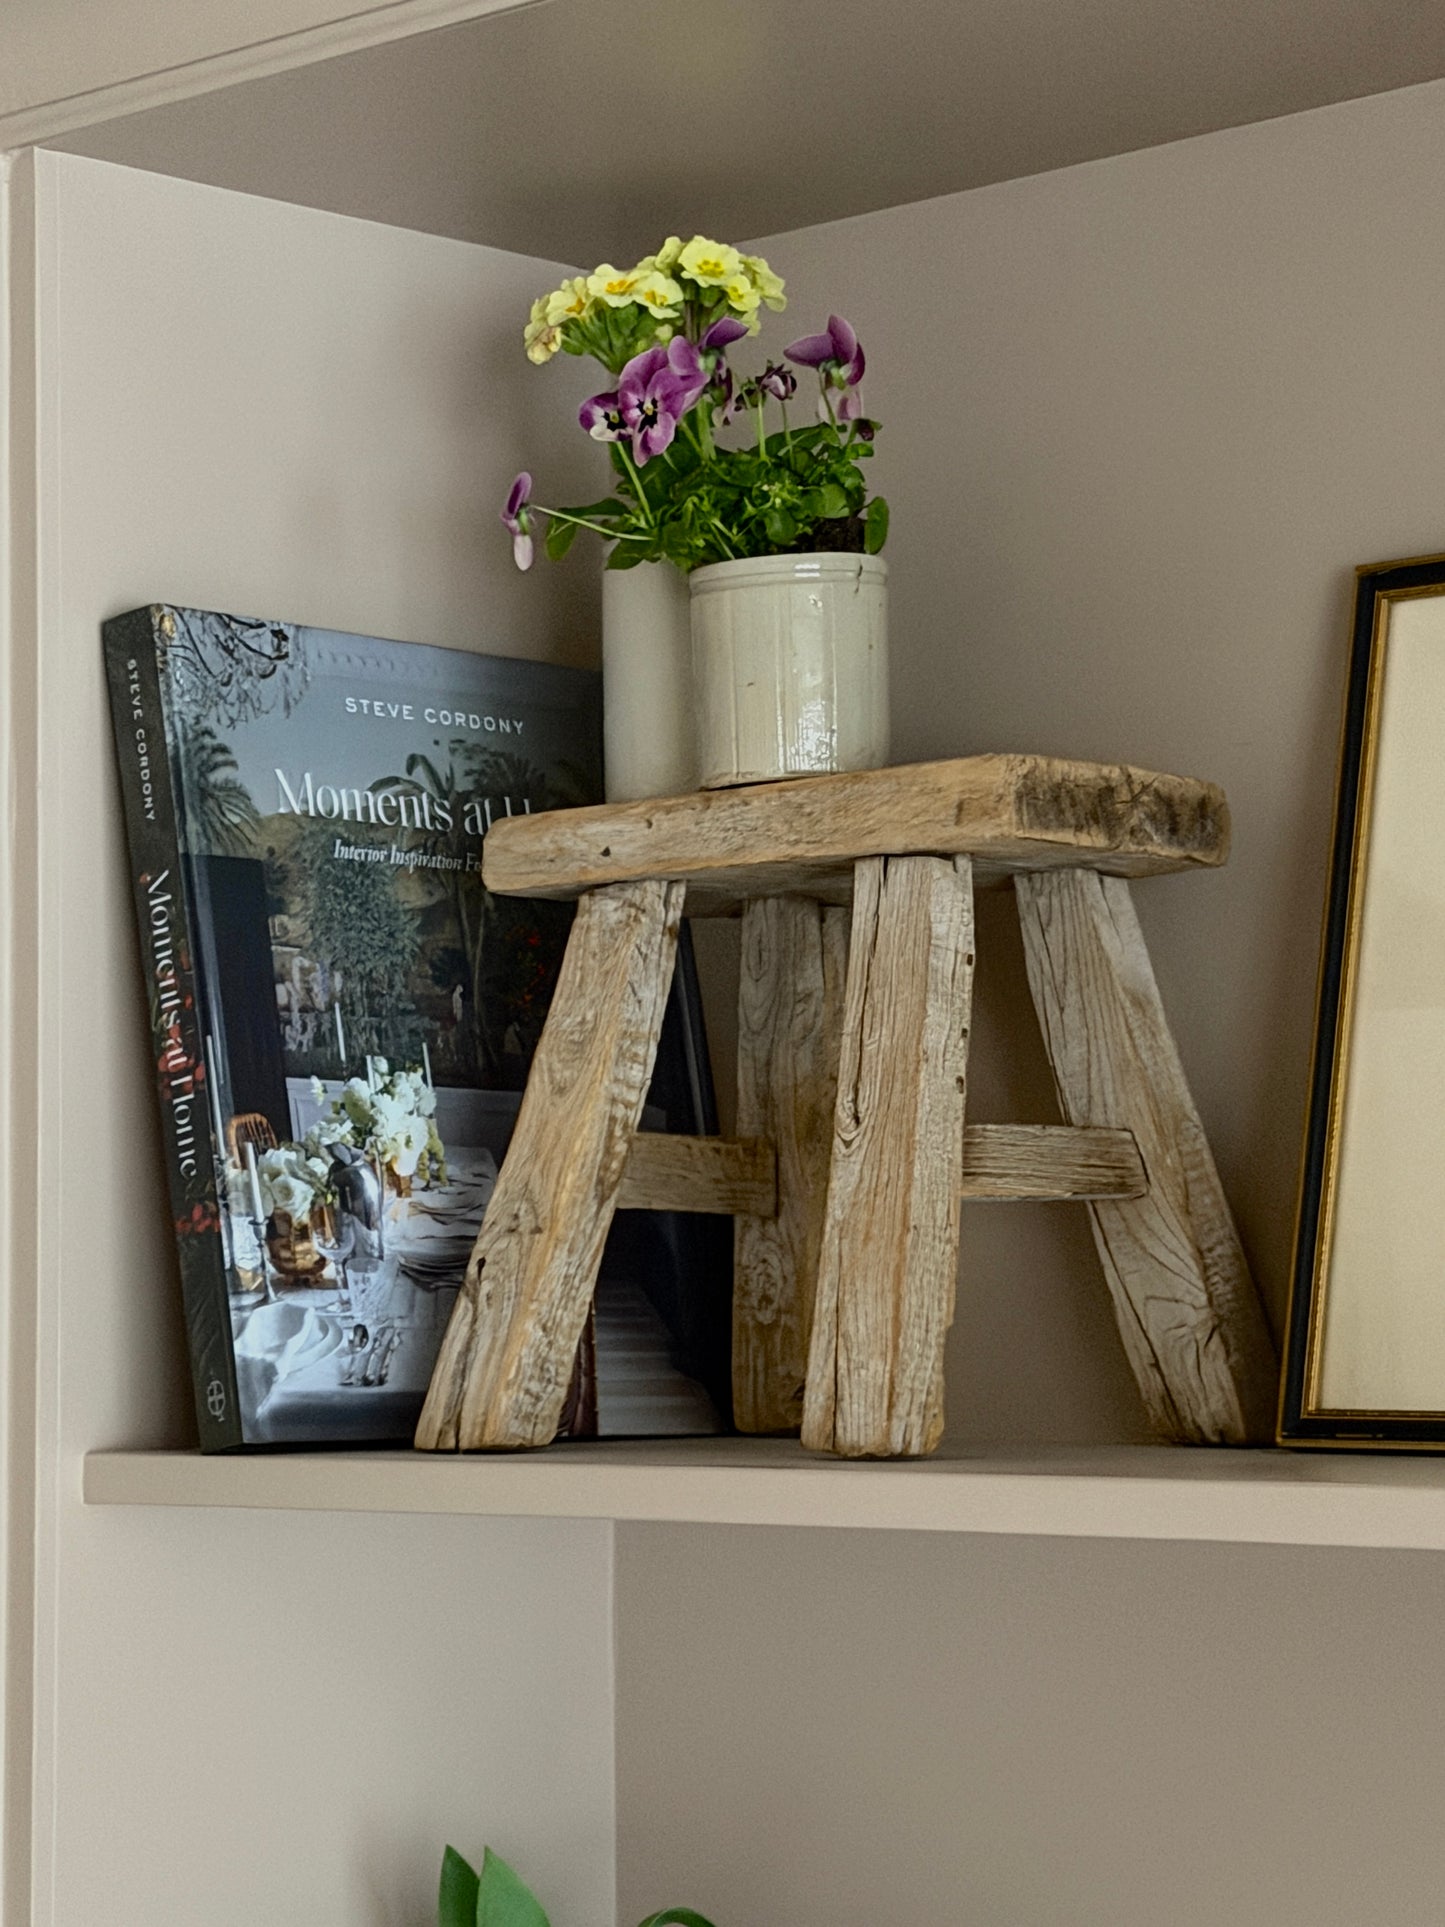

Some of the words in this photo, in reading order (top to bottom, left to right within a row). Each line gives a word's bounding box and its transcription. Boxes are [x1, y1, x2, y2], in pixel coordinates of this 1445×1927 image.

[127, 658, 143, 720] STEVE
[135, 728, 156, 820] CORDONY
[345, 697, 415, 721] STEVE
[424, 708, 523, 735] CORDONY
[274, 768, 454, 832] Moments
[463, 798, 491, 836] at
[333, 838, 387, 863] Interior
[389, 843, 462, 874] Inspiration
[147, 869, 181, 1029] Moments
[163, 1036, 188, 1071] at
[170, 1075, 197, 1178] Home
